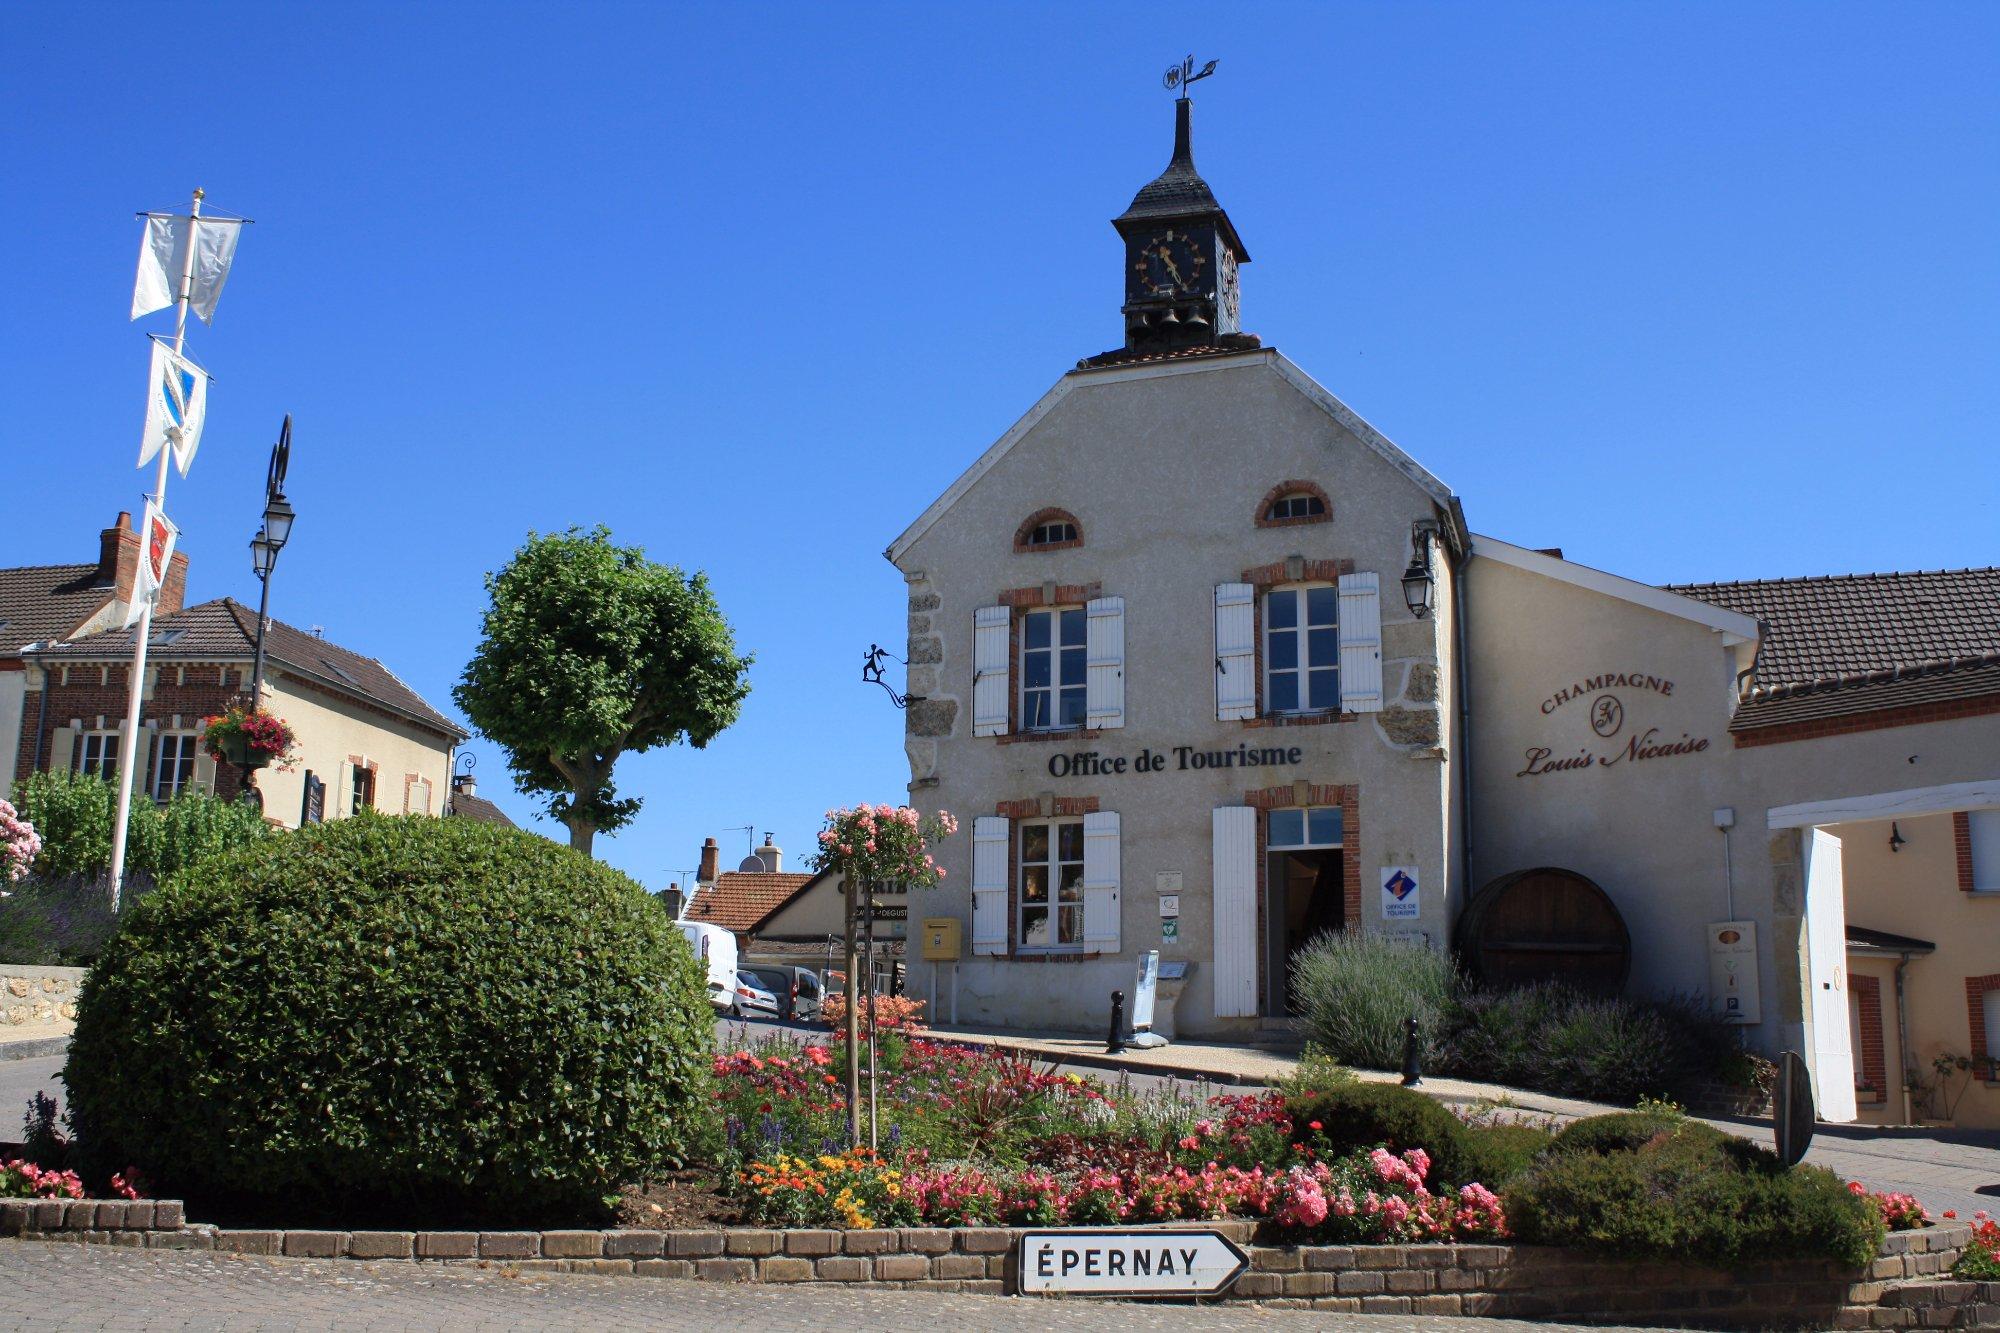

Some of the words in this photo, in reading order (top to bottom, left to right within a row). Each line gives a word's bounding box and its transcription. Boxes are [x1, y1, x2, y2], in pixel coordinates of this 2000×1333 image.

[1541, 673, 1674, 715] CHAMPAGNE
[1049, 752, 1127, 778] Office
[1134, 749, 1165, 773] de
[1172, 743, 1302, 770] Tourisme
[1516, 747, 1594, 778] Louis
[1600, 728, 1710, 768] Nicaise
[1037, 1243, 1198, 1277] ÉPERNAY
